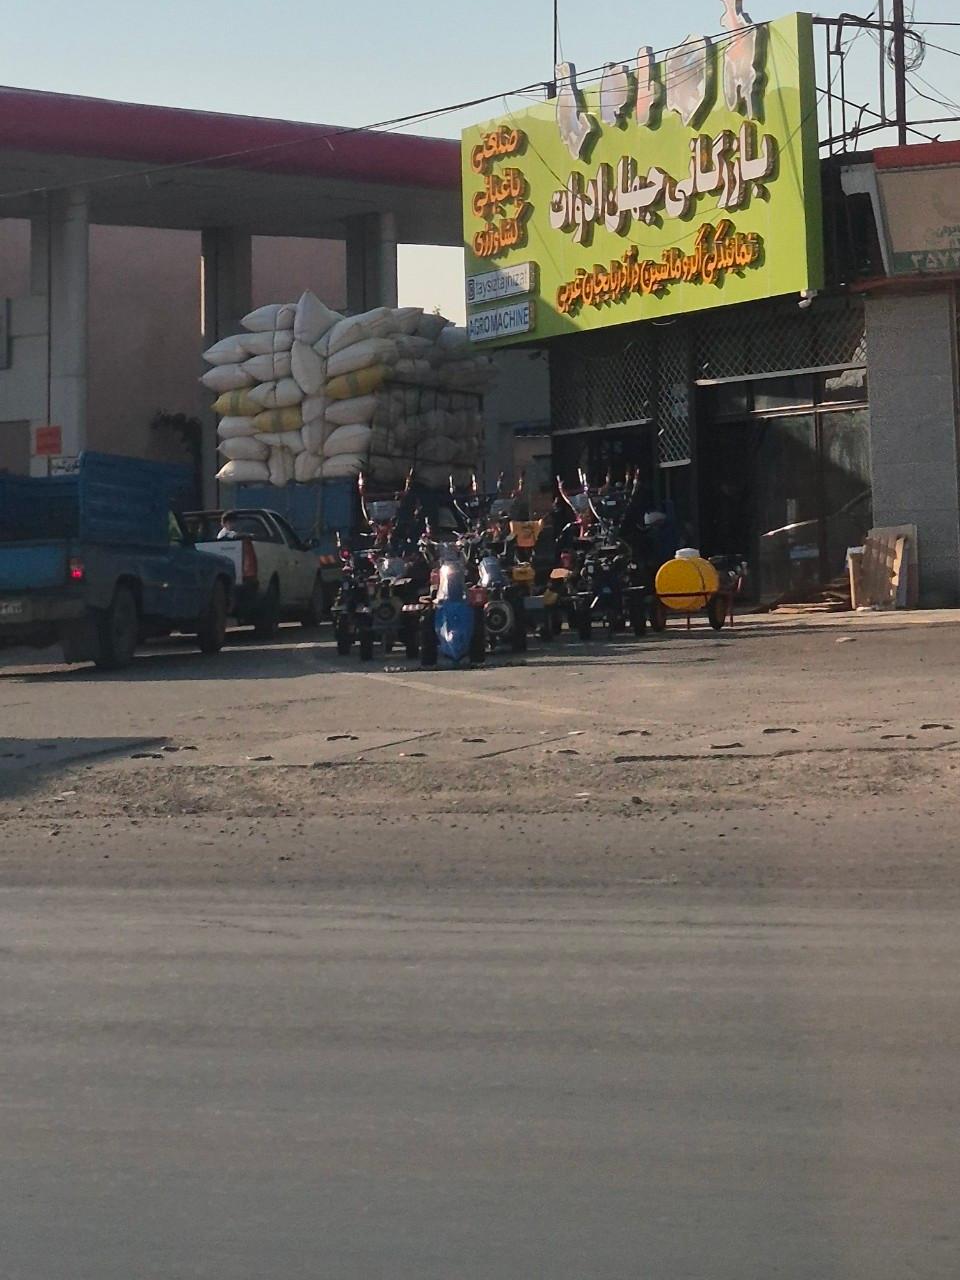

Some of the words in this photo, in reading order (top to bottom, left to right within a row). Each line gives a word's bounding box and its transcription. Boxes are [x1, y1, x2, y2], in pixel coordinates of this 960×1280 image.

[471, 125, 521, 175] صنعتی
[664, 120, 775, 219] بازرگانی
[549, 163, 615, 245] ادوات
[604, 156, 667, 234] جهان
[473, 199, 525, 257] کشاورزی
[702, 219, 758, 284] نمایندگی
[468, 306, 529, 338] AGROMACHINE
